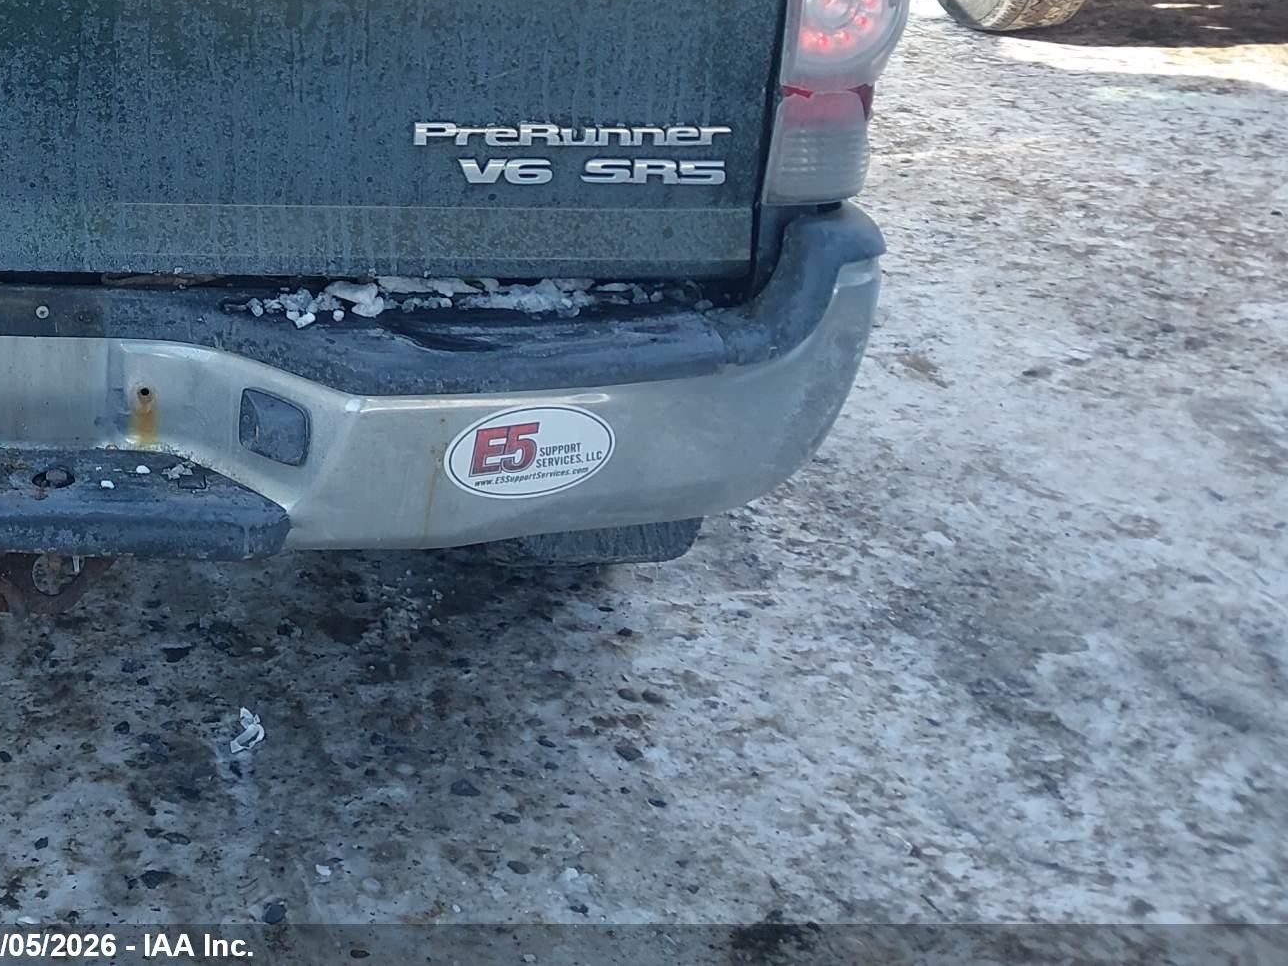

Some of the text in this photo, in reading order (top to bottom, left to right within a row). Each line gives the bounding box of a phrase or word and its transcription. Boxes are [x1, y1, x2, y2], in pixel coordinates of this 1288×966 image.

[413, 122, 732, 147] PreRunner
[458, 158, 726, 185] V6 SR5
[468, 421, 541, 478] E5
[535, 450, 603, 469] SERVICES, LLC
[539, 442, 582, 458] SUPPORT
[474, 466, 590, 488] www.E5SupportServices.com
